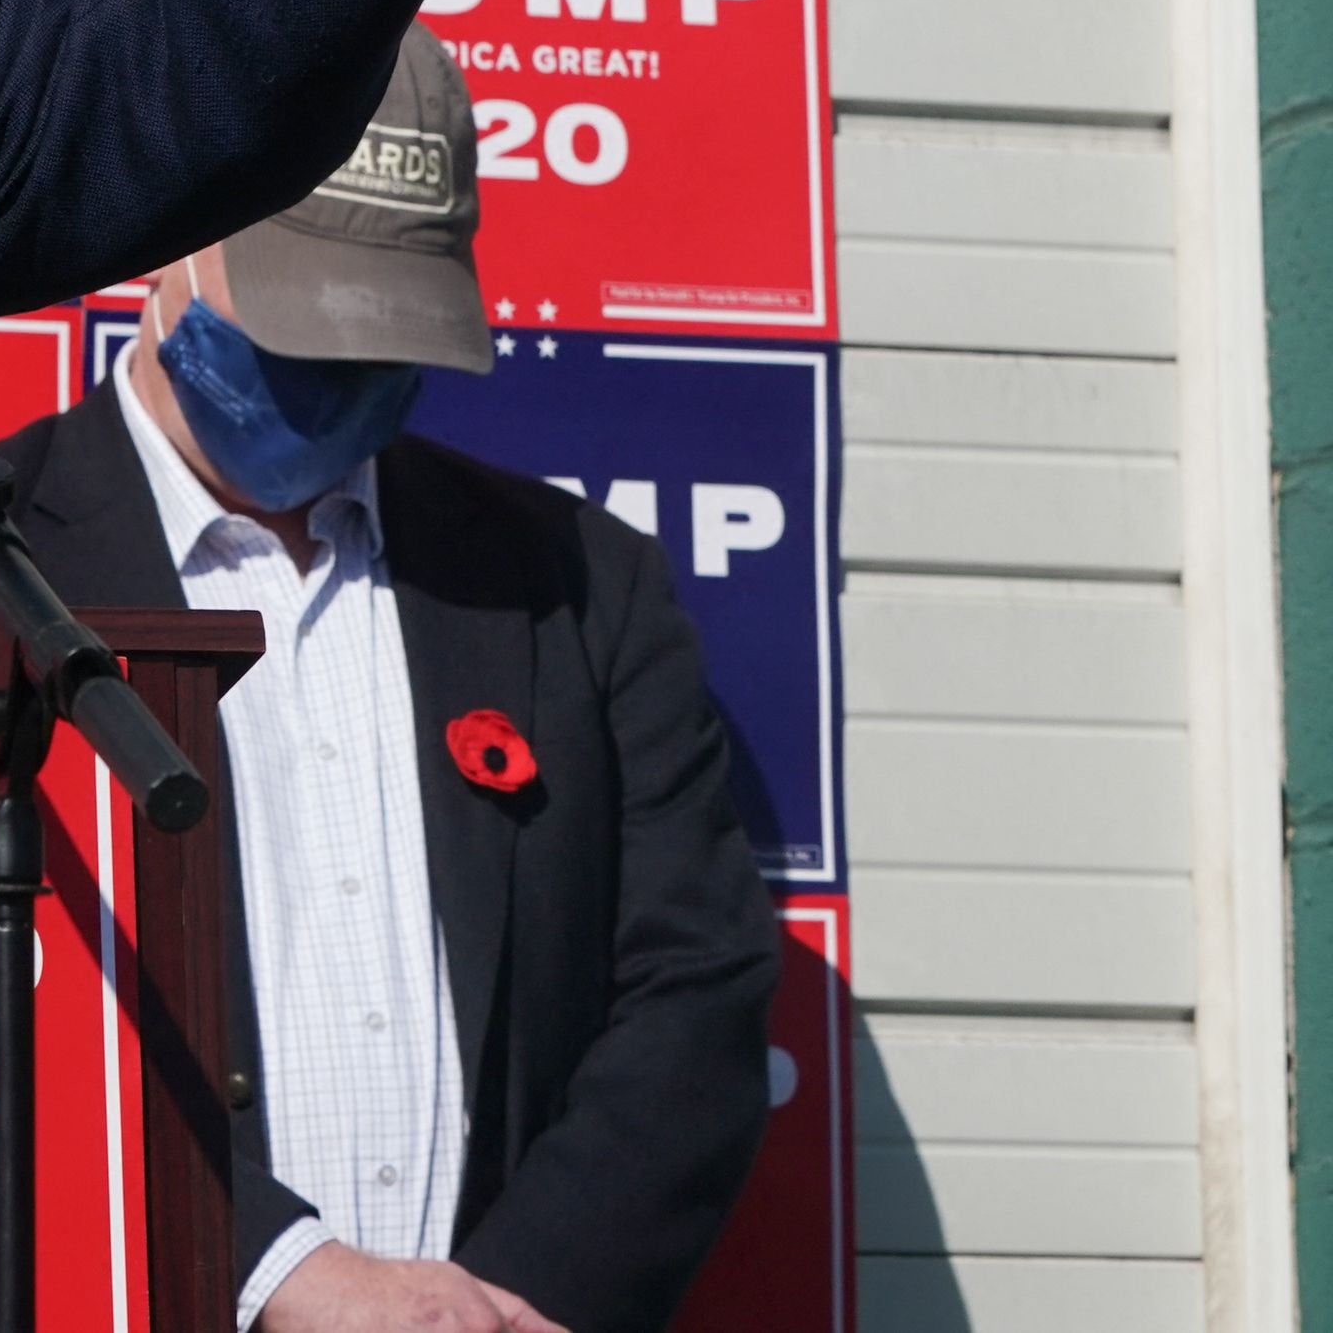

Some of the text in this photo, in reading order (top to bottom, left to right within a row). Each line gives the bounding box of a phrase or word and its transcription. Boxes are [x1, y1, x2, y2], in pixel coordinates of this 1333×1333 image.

[532, 45, 659, 79] GREAT!
[347, 138, 441, 184] ARDS
[472, 99, 628, 185] 20
